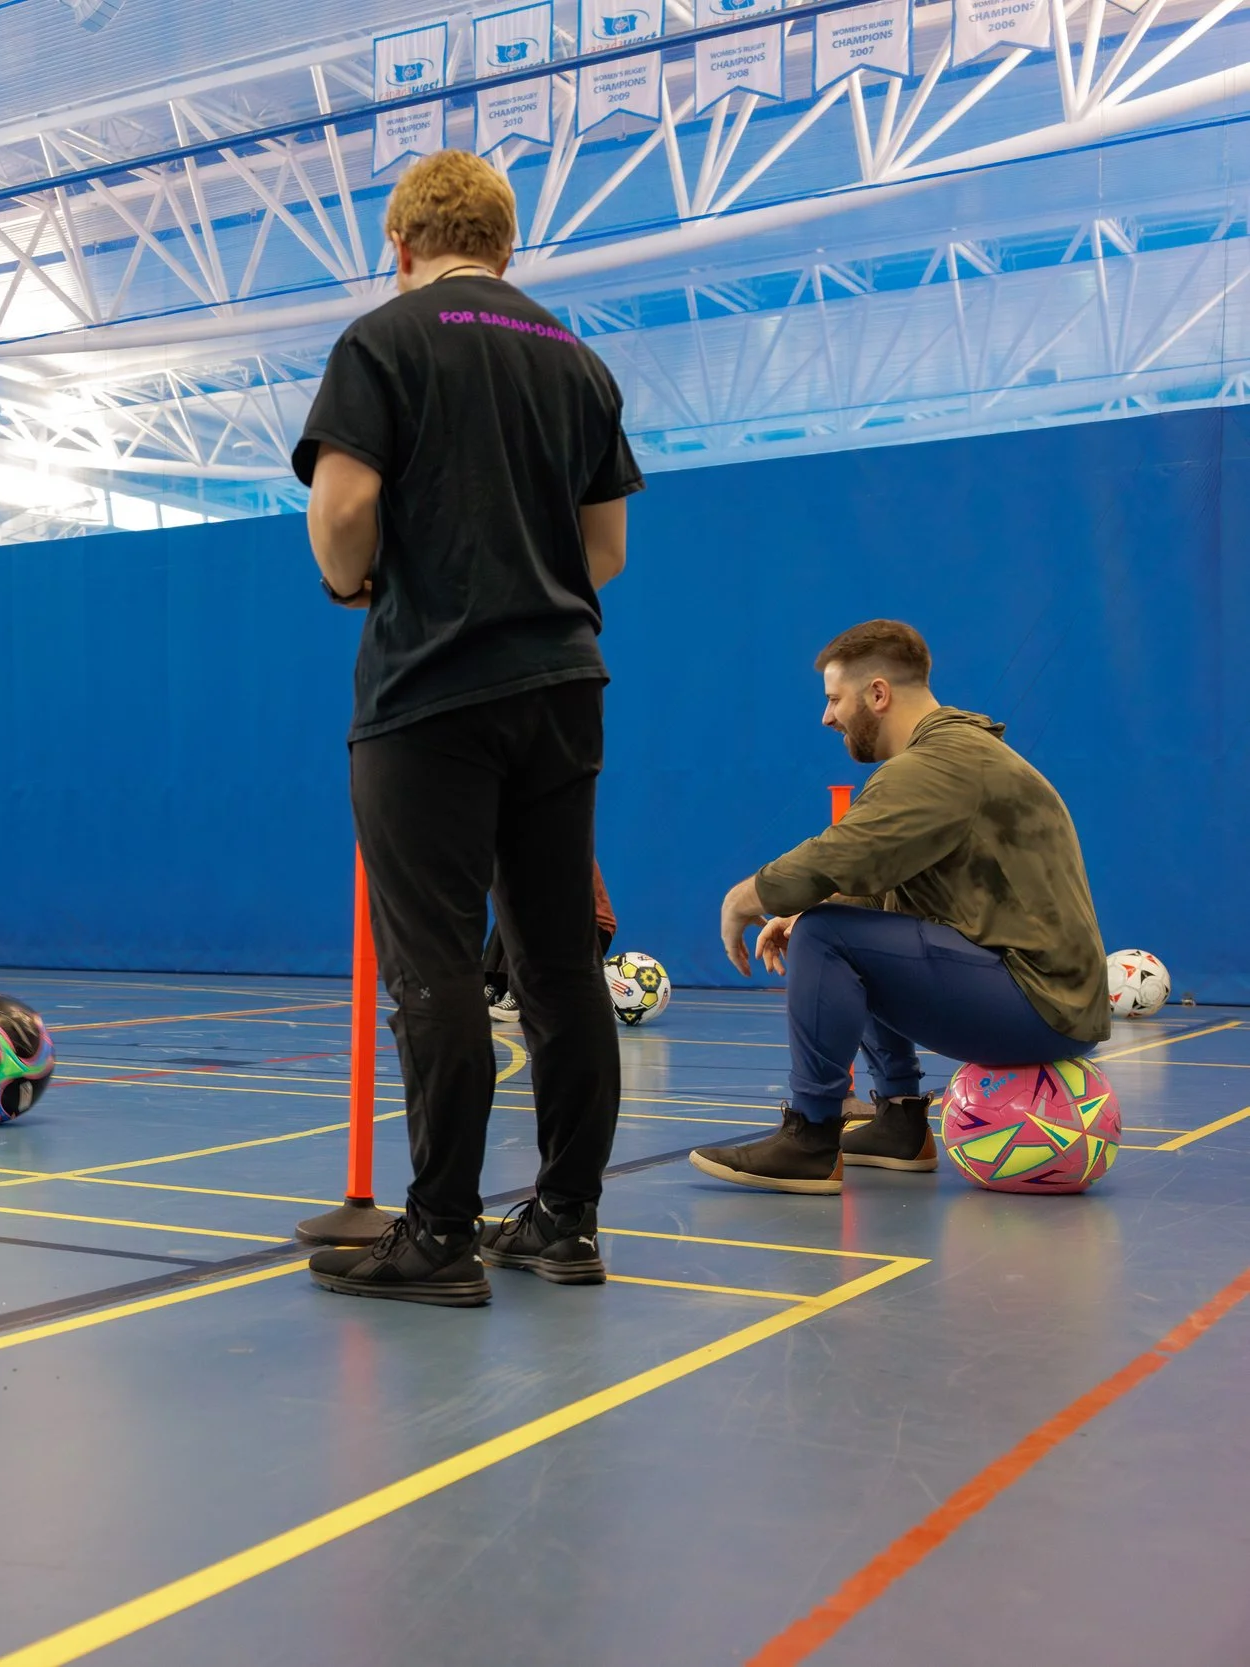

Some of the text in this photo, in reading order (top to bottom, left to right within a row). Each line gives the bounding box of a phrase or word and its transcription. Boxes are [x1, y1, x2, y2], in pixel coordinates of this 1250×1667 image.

[969, 1, 1036, 22] CHAMPIONS
[832, 18, 894, 36] WOMEN'S RUGBY
[988, 19, 1016, 32] 2006
[832, 30, 893, 48] CHAMPIONS
[849, 46, 874, 57] 2007
[710, 52, 765, 71] CHAMPIONS
[726, 69, 749, 80] 2008
[593, 77, 646, 94] CHAMPIONS
[608, 92, 630, 103] 2009
[488, 102, 537, 119] CHAMPIONS
[386, 121, 430, 136] CHAMPIONS
[502, 116, 523, 128] 2010
[398, 134, 418, 145] 2011
[439, 311, 475, 324] FOR
